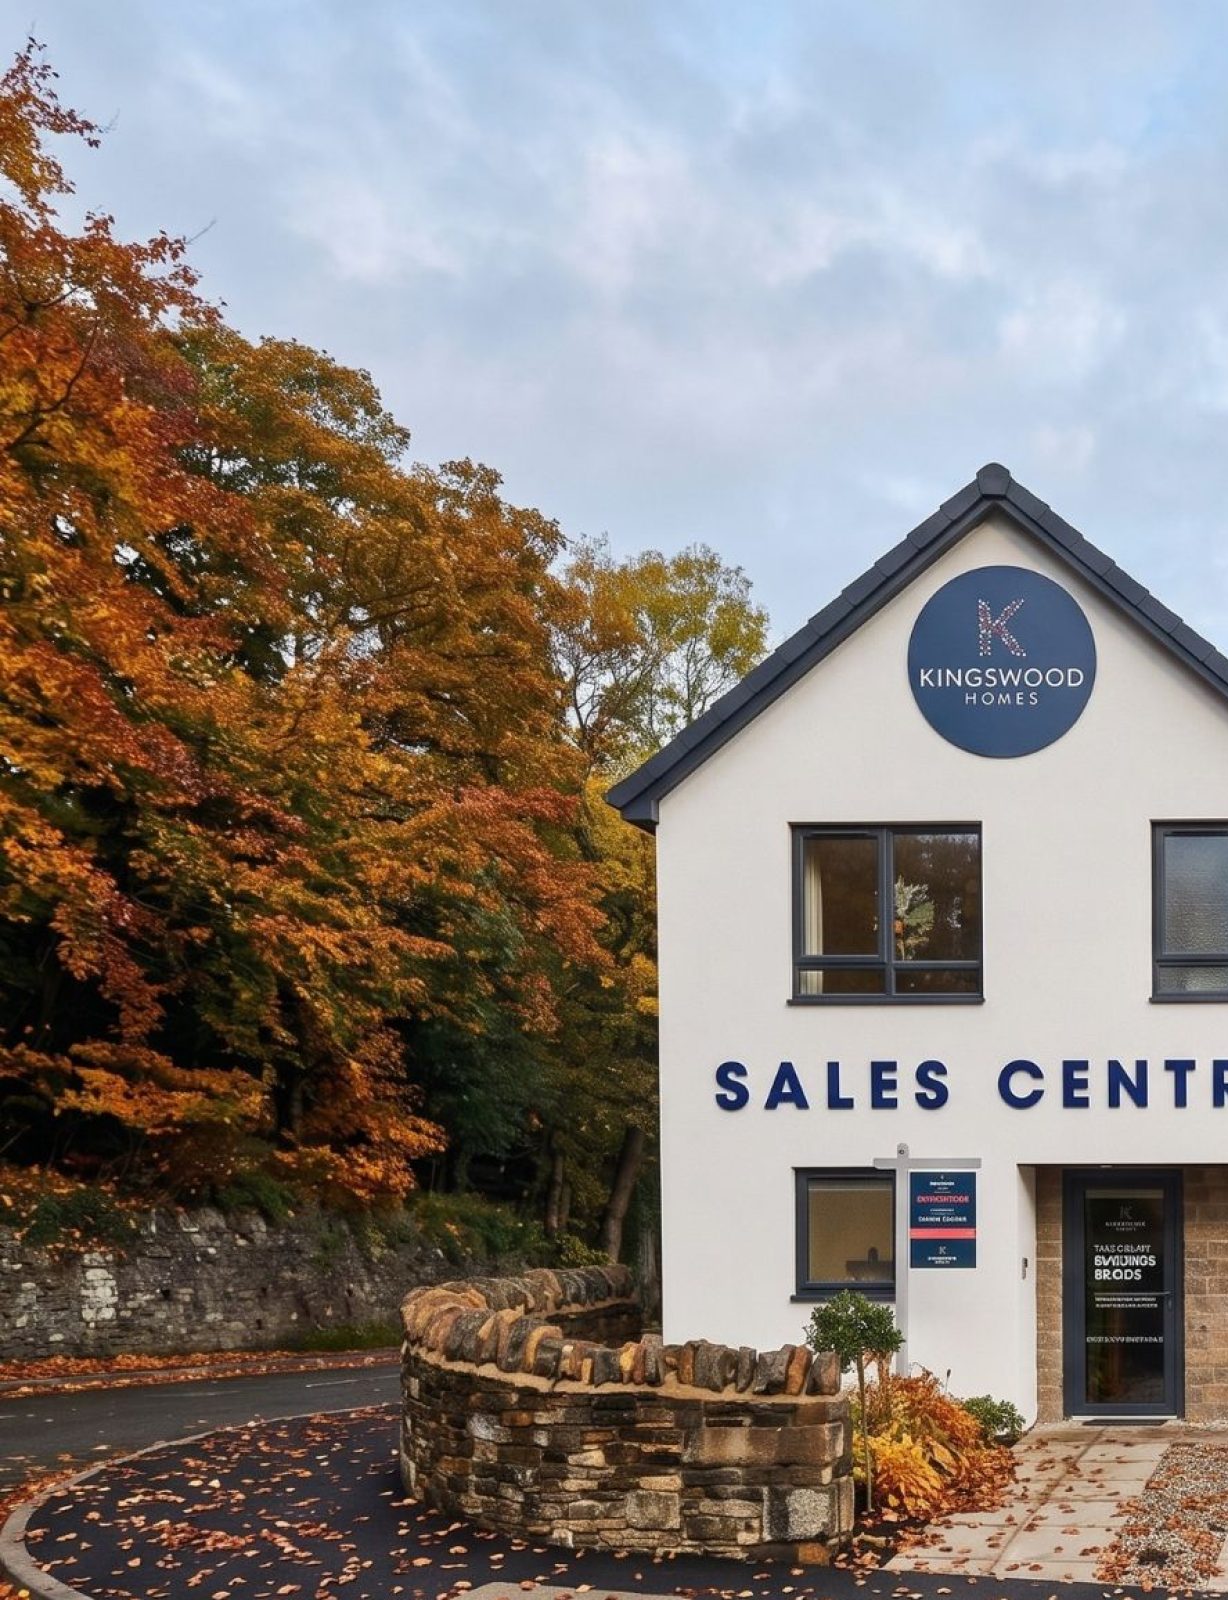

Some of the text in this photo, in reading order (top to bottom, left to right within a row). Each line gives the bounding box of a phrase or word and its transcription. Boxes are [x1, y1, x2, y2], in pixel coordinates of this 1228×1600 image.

[977, 598, 1027, 657] K
[919, 667, 1085, 688] KINGSWOOD
[965, 691, 1038, 706] HOMES
[715, 1059, 949, 1111] SALES
